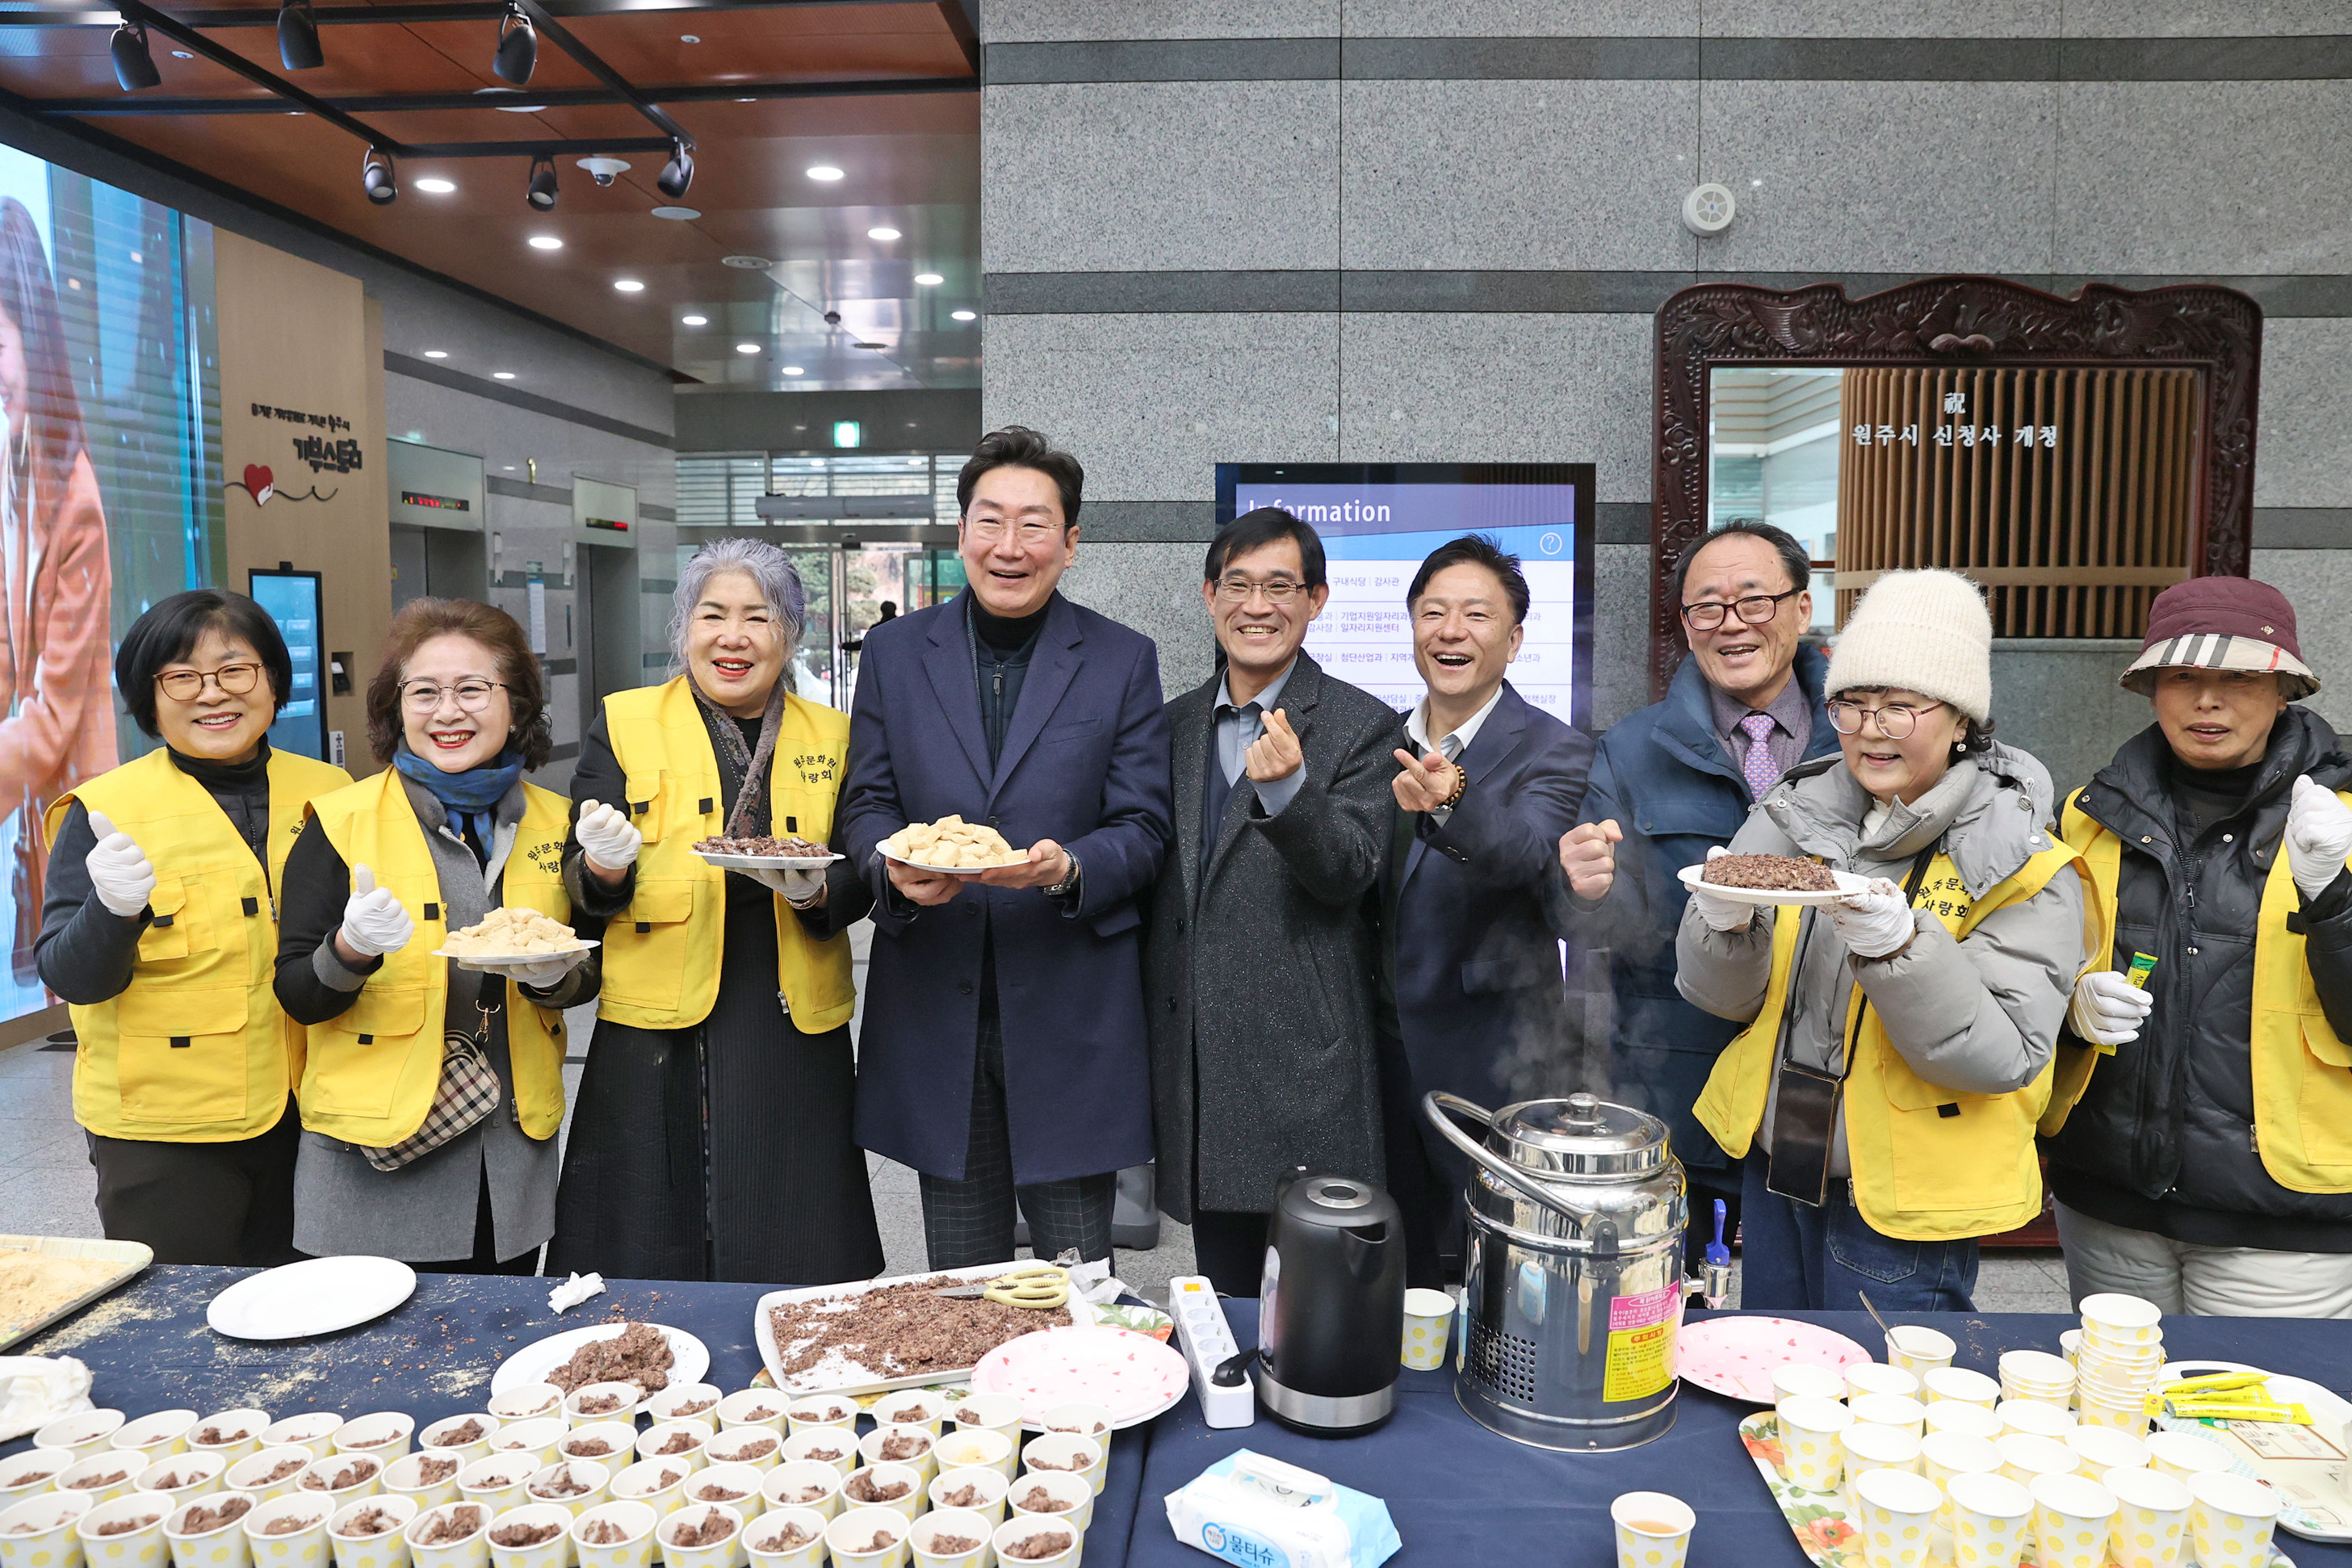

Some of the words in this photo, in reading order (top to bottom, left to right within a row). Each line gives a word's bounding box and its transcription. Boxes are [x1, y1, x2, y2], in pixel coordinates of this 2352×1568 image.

[1943, 392, 1966, 414] 祝
[1852, 423, 1918, 447] 원주시
[1932, 424, 2002, 447] 신청사
[2014, 425, 2057, 448] 개청
[292, 435, 363, 474] 기부스토리
[1249, 499, 1390, 522] Iformation
[1332, 576, 1366, 587] 구내식당
[1374, 576, 1399, 587] 감사관
[1341, 623, 1399, 633] 일자리지원센터
[1341, 652, 1382, 663] 첨단산업과
[793, 754, 836, 769] 원주문화원
[1229, 1535, 1275, 1566] 물티슈
